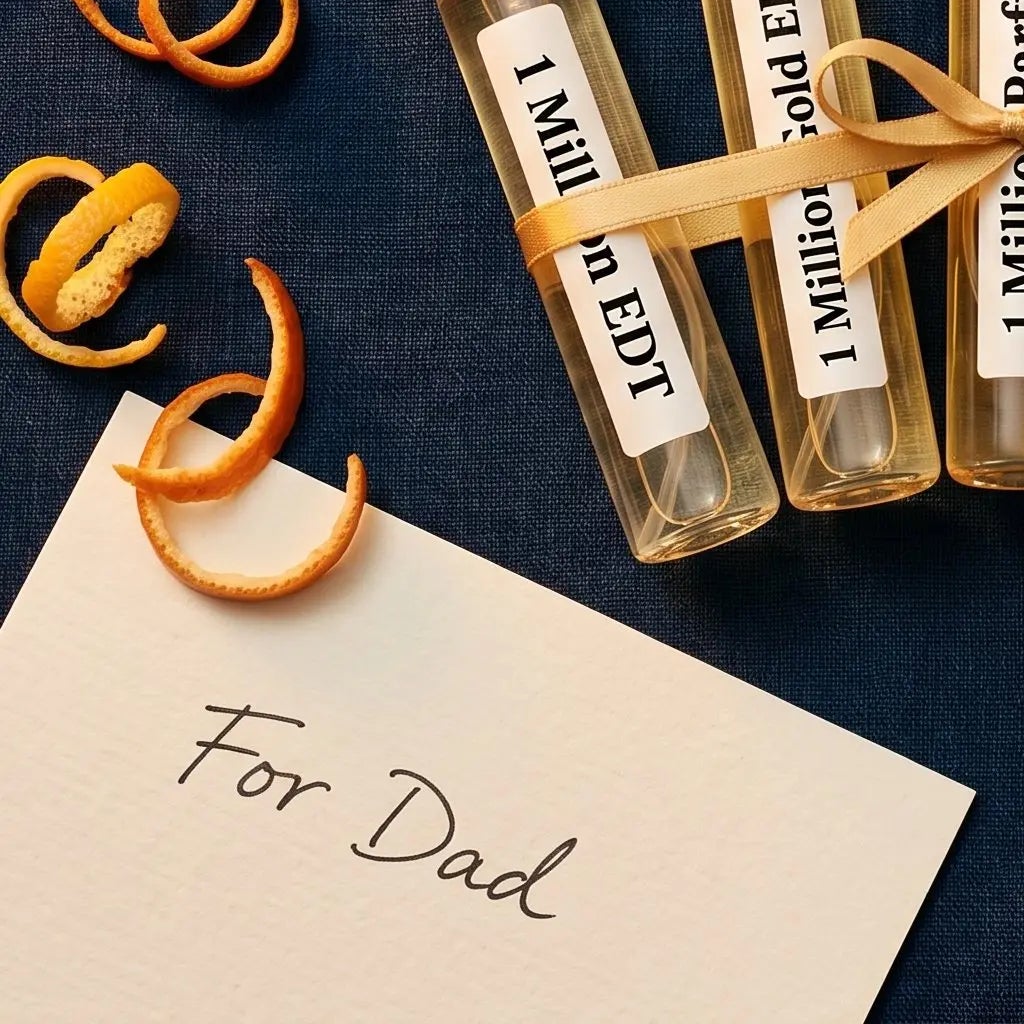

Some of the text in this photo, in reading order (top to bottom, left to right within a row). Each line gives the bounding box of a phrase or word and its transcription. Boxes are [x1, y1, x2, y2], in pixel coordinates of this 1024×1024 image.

[766, 50, 819, 143] old
[513, 54, 675, 400] 1 Milln EDT
[818, 344, 857, 367] 1
[177, 704, 578, 920] For Dad
